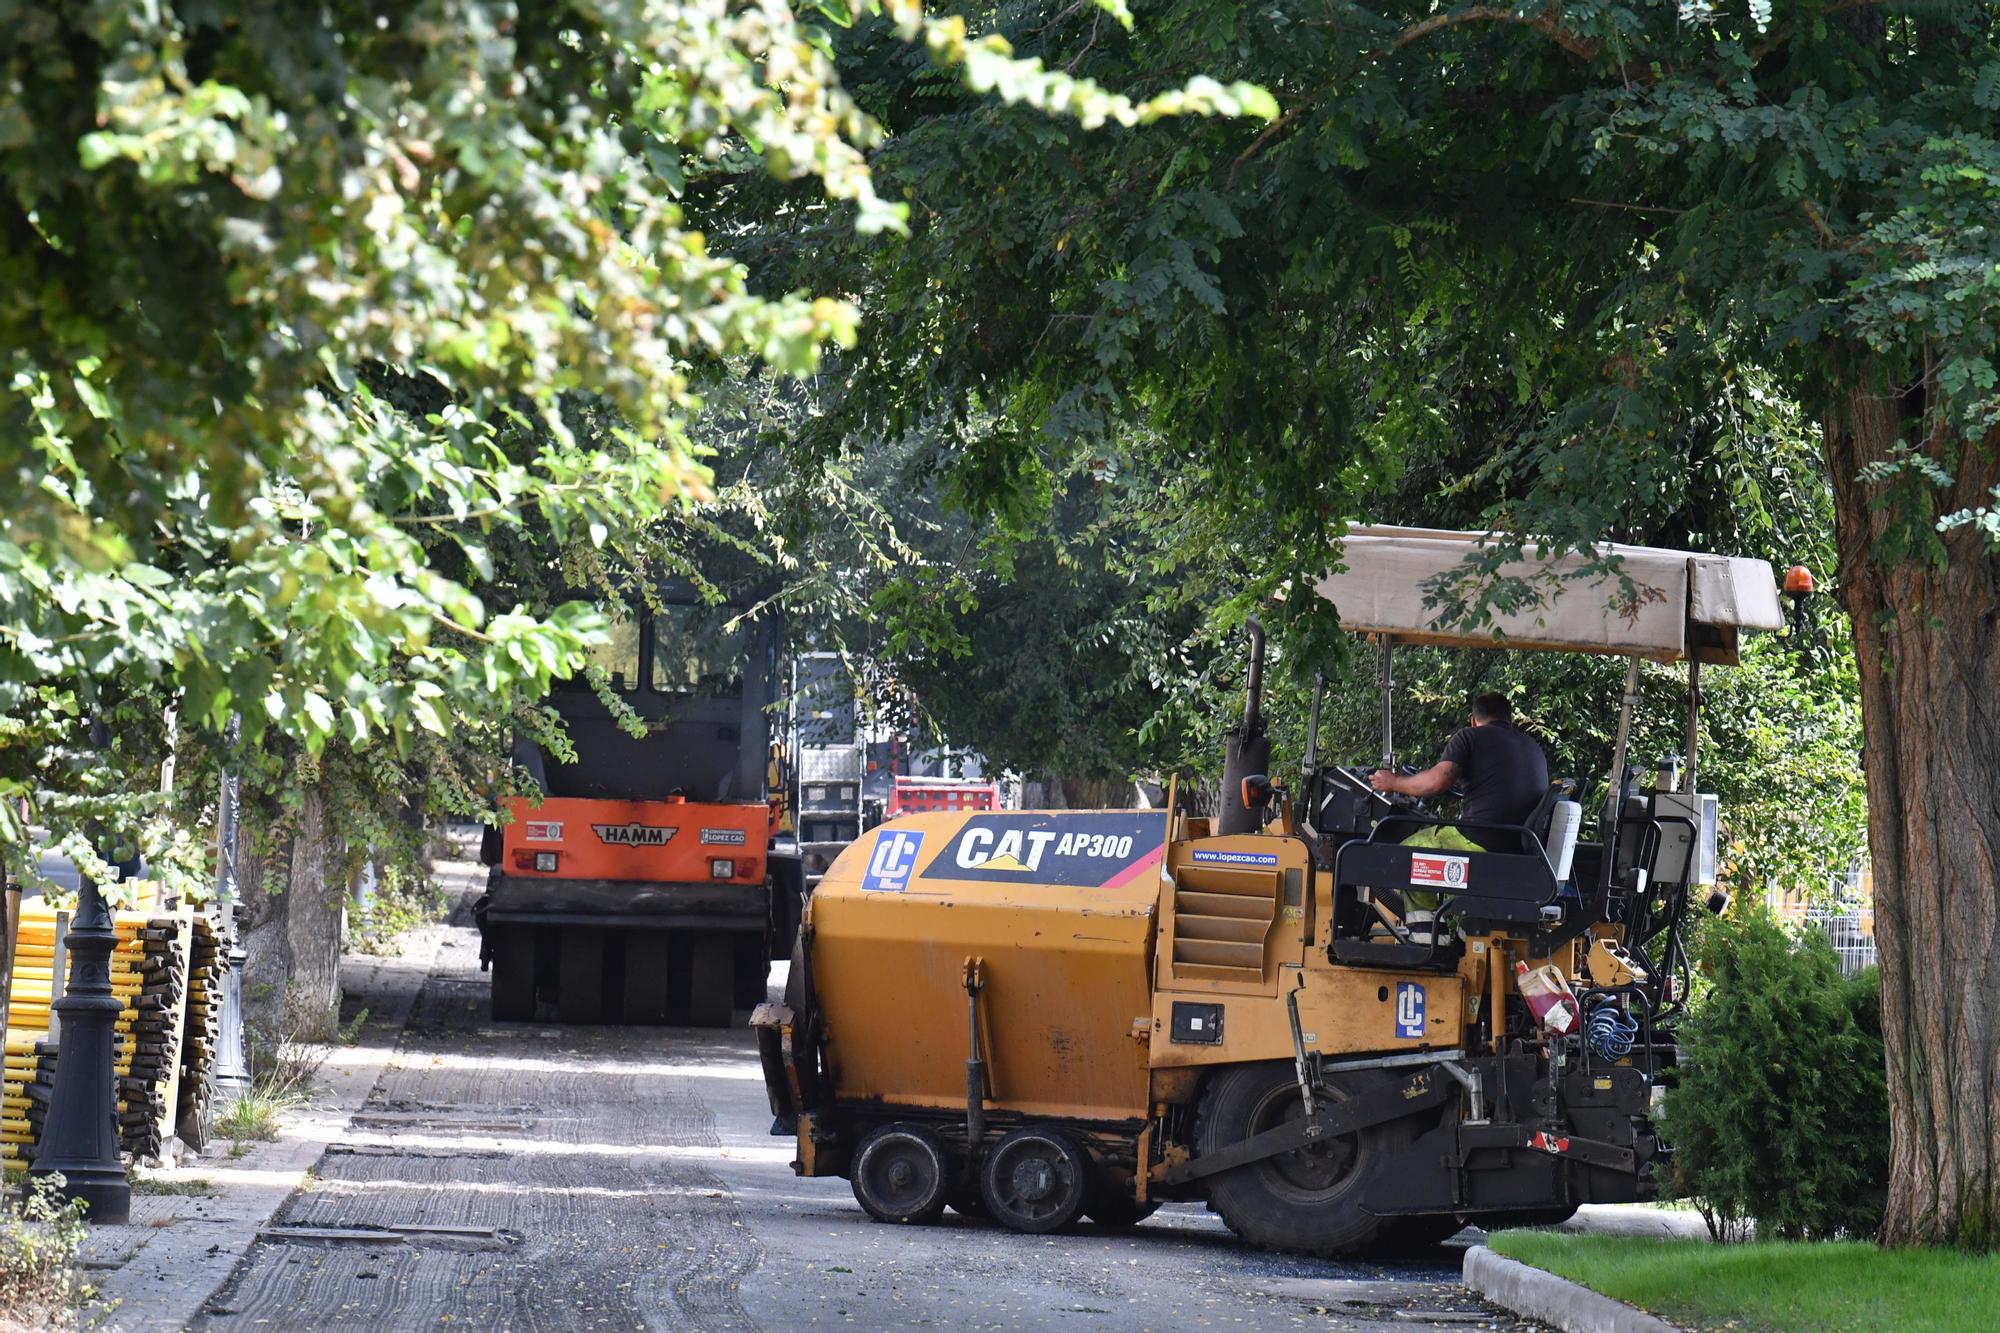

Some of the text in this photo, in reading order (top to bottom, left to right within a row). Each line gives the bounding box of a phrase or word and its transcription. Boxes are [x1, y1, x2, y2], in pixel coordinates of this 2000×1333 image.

[605, 828, 663, 842] HAMM
[956, 827, 1133, 872] CAT AP300
[1194, 852, 1276, 864] www.lopezcao.com
